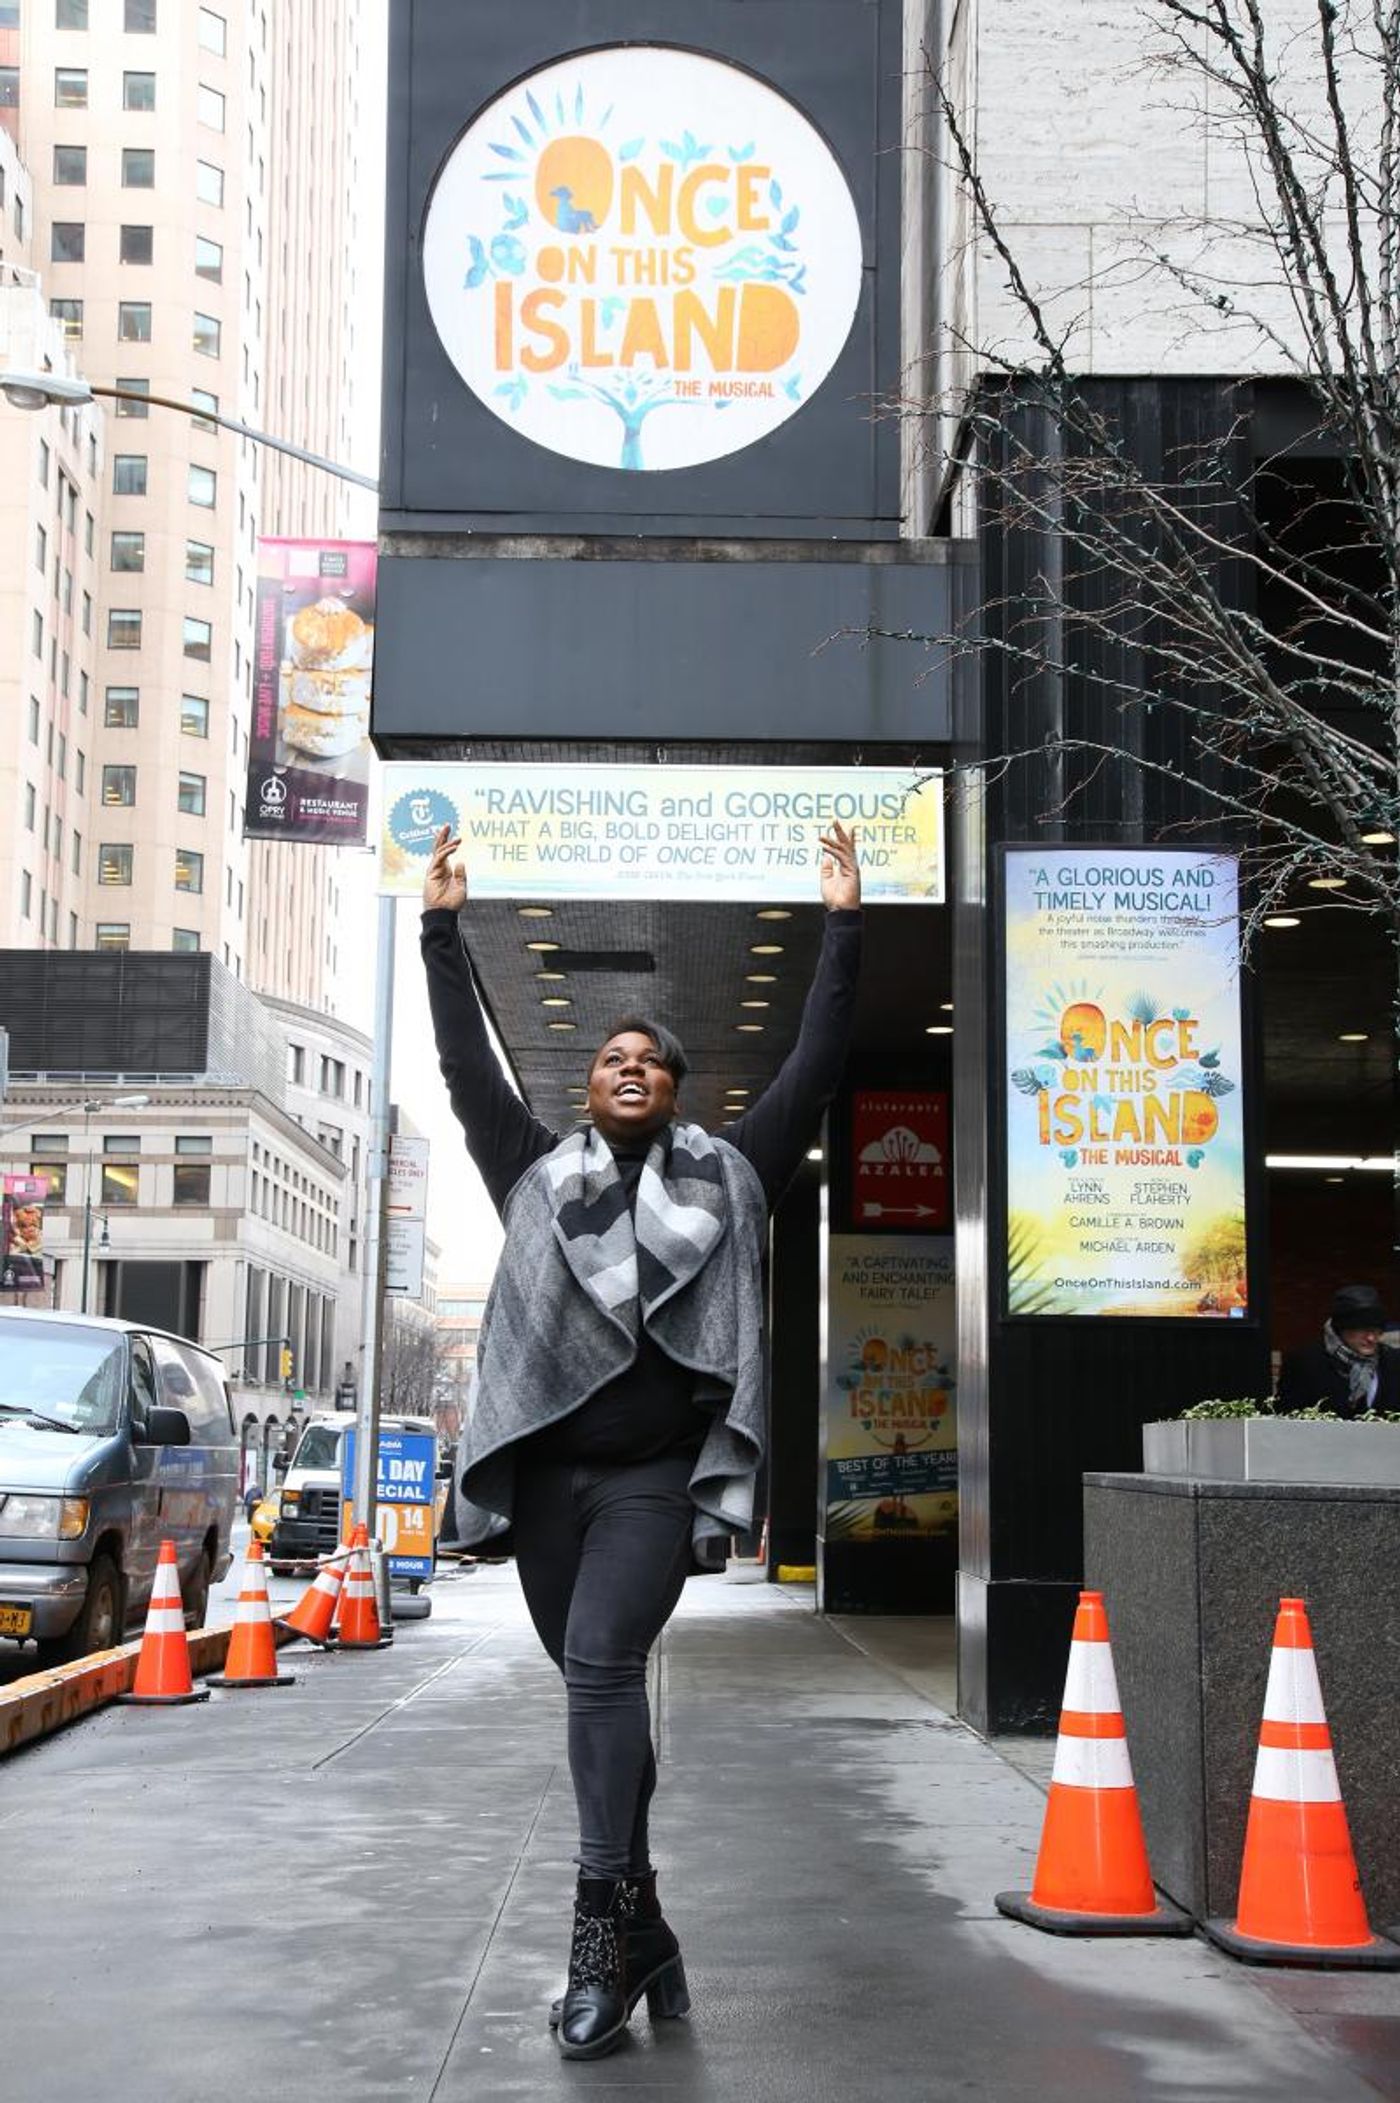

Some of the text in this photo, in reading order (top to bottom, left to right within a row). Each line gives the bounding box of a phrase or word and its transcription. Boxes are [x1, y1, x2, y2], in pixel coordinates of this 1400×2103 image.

[535, 136, 771, 247] ONCE
[536, 244, 696, 286] ON THIS
[494, 281, 800, 374] ISLAND
[674, 379, 775, 398] THE MUSICAL
[660, 791, 713, 818] and
[470, 820, 531, 838] WHAT
[538, 821, 553, 839] A
[560, 821, 598, 842] BIG,
[606, 822, 660, 840] BOLD
[668, 823, 753, 841] DELIGHT
[761, 823, 780, 842] IT
[788, 824, 805, 842] IS
[488, 844, 528, 861] THE
[536, 844, 611, 862] WORLD
[619, 845, 649, 863] OF
[657, 846, 717, 864] ONCE
[724, 847, 759, 864] ON
[766, 847, 808, 867] THIS
[1057, 867, 1164, 888] GLORIOUS
[1172, 869, 1215, 888] AND
[1032, 892, 1211, 912] TIMELY MUSICAL!
[1060, 1002, 1200, 1070] ONCE
[1062, 1067, 1158, 1093] ON THIS
[1037, 1089, 1219, 1146] ISLAND
[1079, 1148, 1183, 1167] THE MUSICAL
[860, 1165, 943, 1177] AZALEA
[1071, 1182, 1188, 1194] LYNN STEPHEN
[1063, 1193, 1192, 1205] AHRENS FLAHERTY
[1069, 1216, 1120, 1228] CAMILLE
[1139, 1218, 1184, 1229] BROWN
[1079, 1240, 1175, 1254] MICHAEL ARDEN
[842, 1272, 869, 1284] AND
[1054, 1277, 1202, 1290] OnceOnThisIsland.com
[860, 1287, 896, 1299] FAIRY
[862, 1337, 939, 1376] ONCE
[849, 1389, 948, 1418] ISLAND
[389, 1459, 426, 1482] DAY
[894, 1455, 919, 1468] THE
[377, 1484, 426, 1499] ECIAL
